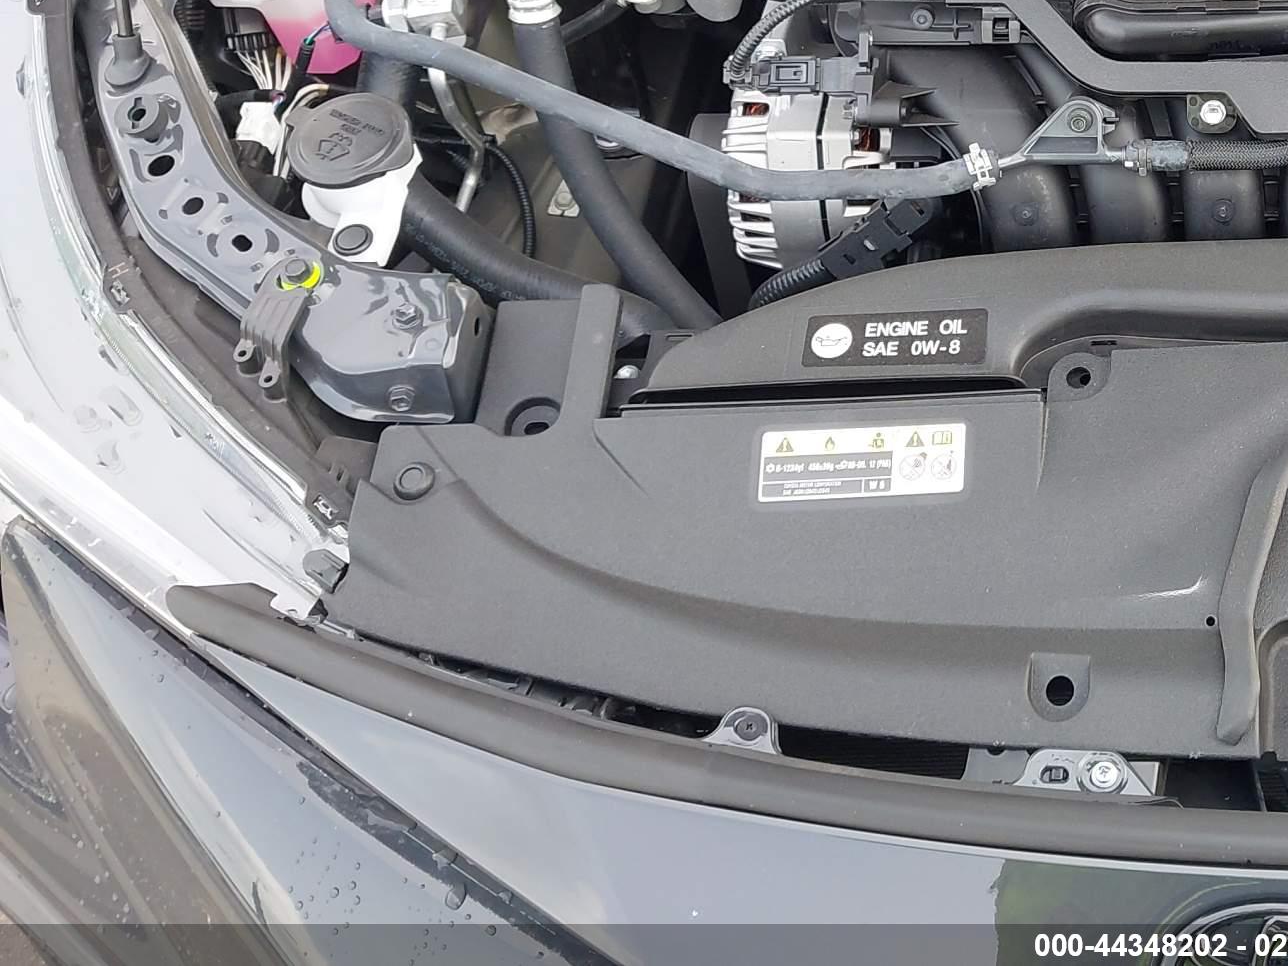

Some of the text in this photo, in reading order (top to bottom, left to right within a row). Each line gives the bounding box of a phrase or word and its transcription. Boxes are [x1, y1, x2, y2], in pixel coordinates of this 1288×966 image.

[865, 319, 968, 338] ENGINE OIL
[862, 340, 961, 357] SAE 0W-8
